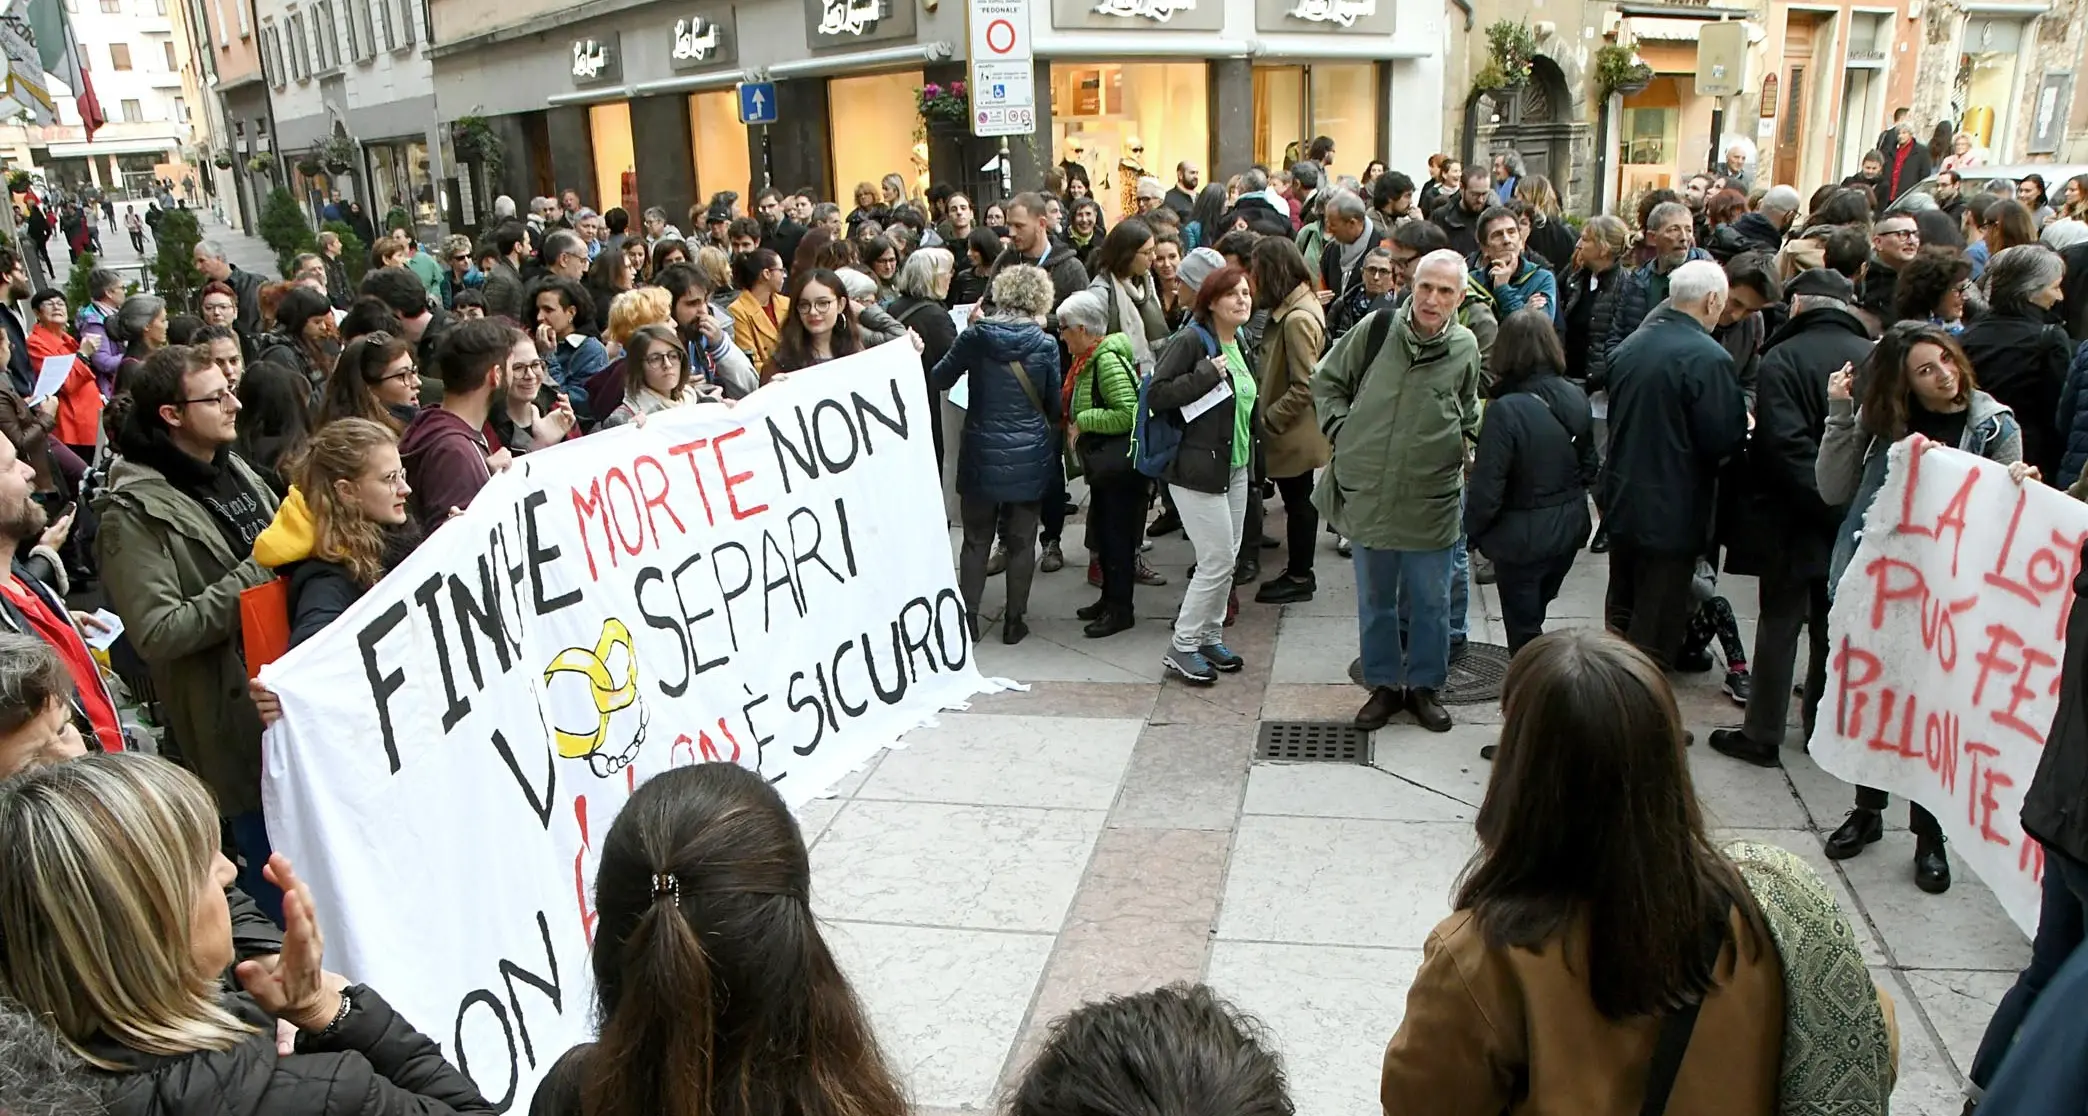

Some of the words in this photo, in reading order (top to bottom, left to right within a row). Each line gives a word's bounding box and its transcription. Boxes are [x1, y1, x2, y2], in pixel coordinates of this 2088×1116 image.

[571, 427, 769, 582] MORTE
[765, 379, 908, 493] NON
[1897, 434, 1981, 578] LA
[634, 498, 857, 698] SEPARI
[787, 588, 967, 757] SICURO
[1972, 623, 2061, 745] FE
[1833, 634, 1960, 796] PILLON
[1964, 741, 2015, 847] TE
